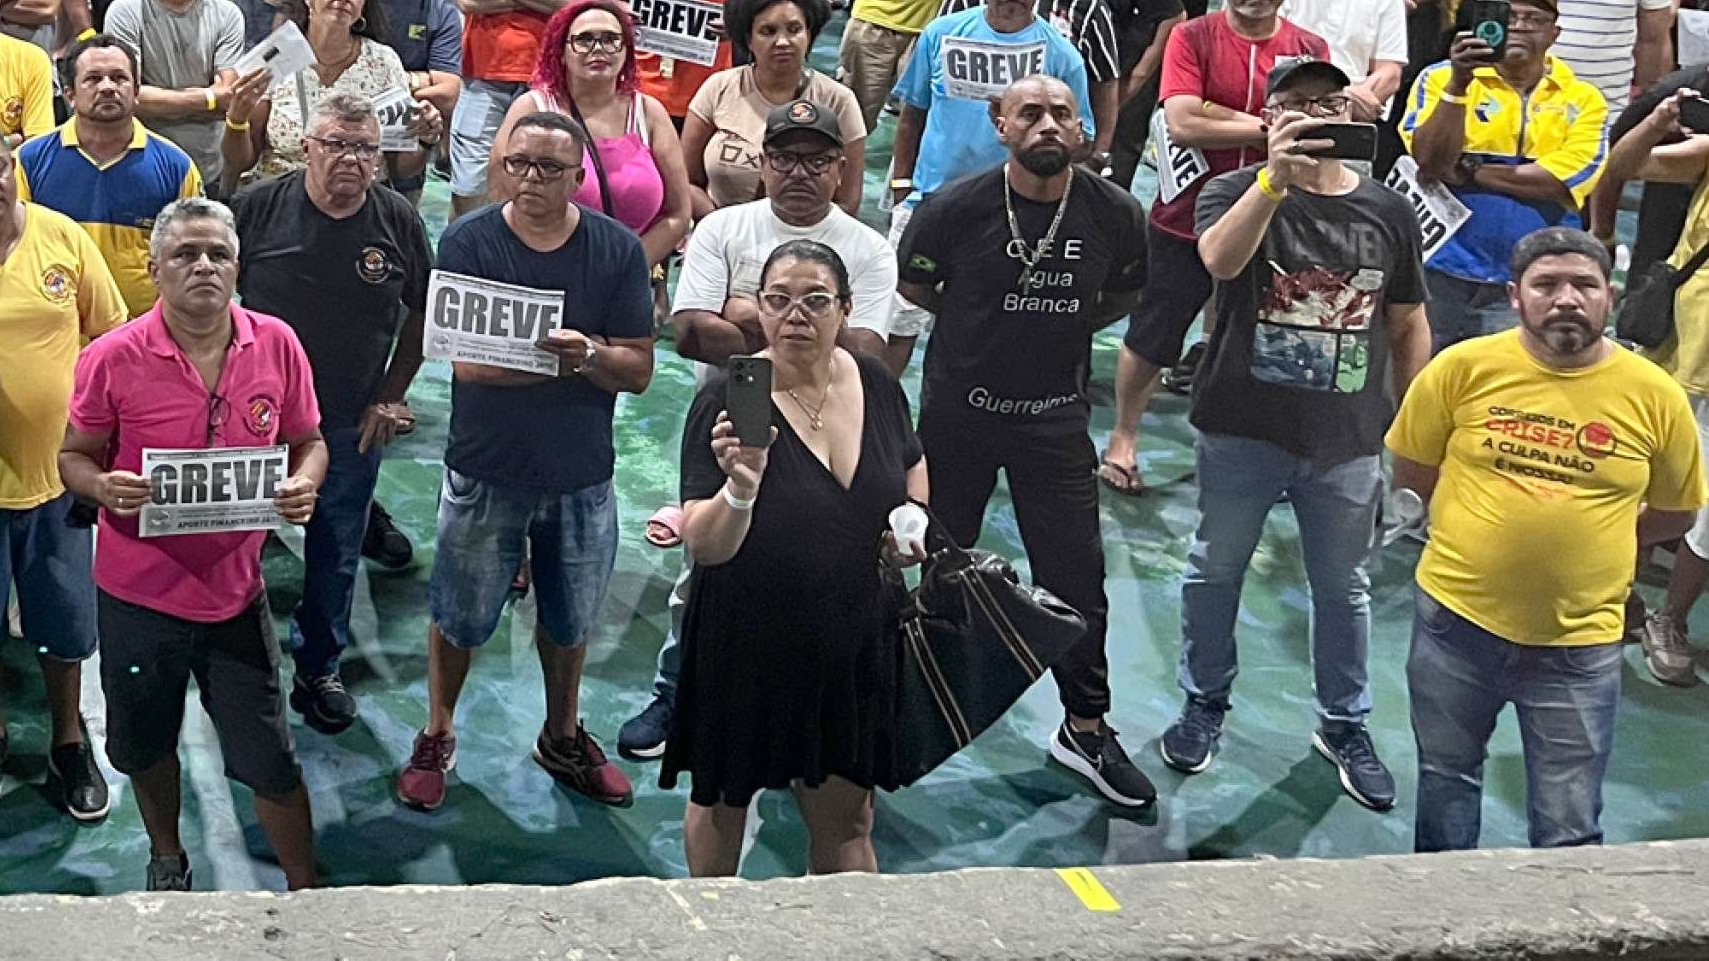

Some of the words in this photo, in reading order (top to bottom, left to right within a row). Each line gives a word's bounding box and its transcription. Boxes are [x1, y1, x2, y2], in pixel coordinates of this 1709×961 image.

[947, 48, 1043, 85] GREVE
[434, 285, 560, 341] GREVE
[1003, 292, 1081, 313] Branca
[1482, 437, 1494, 449] A
[1498, 440, 1550, 463] CULPA
[1554, 454, 1595, 473] NÃO
[150, 457, 284, 506] GREVE
